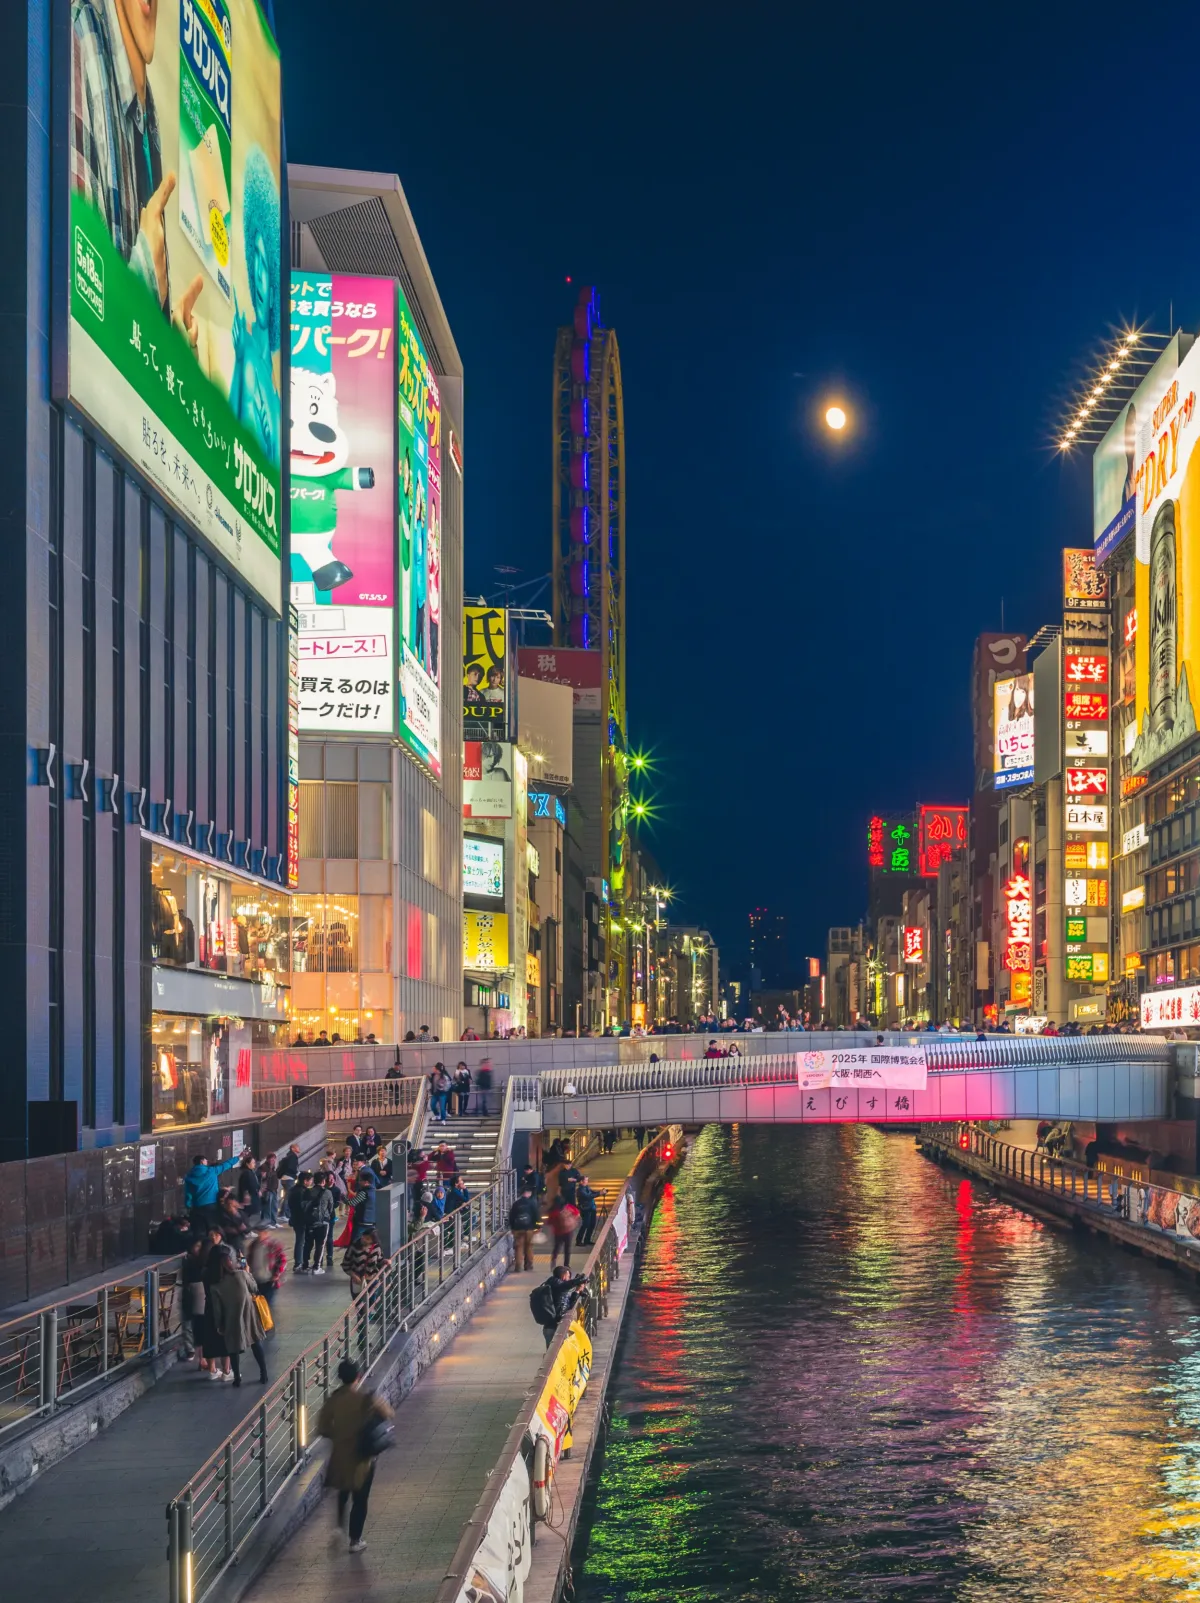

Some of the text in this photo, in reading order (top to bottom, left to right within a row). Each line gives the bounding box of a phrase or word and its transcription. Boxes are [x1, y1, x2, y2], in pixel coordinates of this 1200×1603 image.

[290, 325, 392, 359] パーク!
[233, 437, 279, 537] サロンパス
[538, 654, 556, 673] 税
[1068, 809, 1105, 823] 白木屋
[1005, 875, 1031, 971] 大阪王将
[832, 1054, 925, 1066] 2025年 国際博覧会を
[806, 1096, 910, 1111] えびす橋
